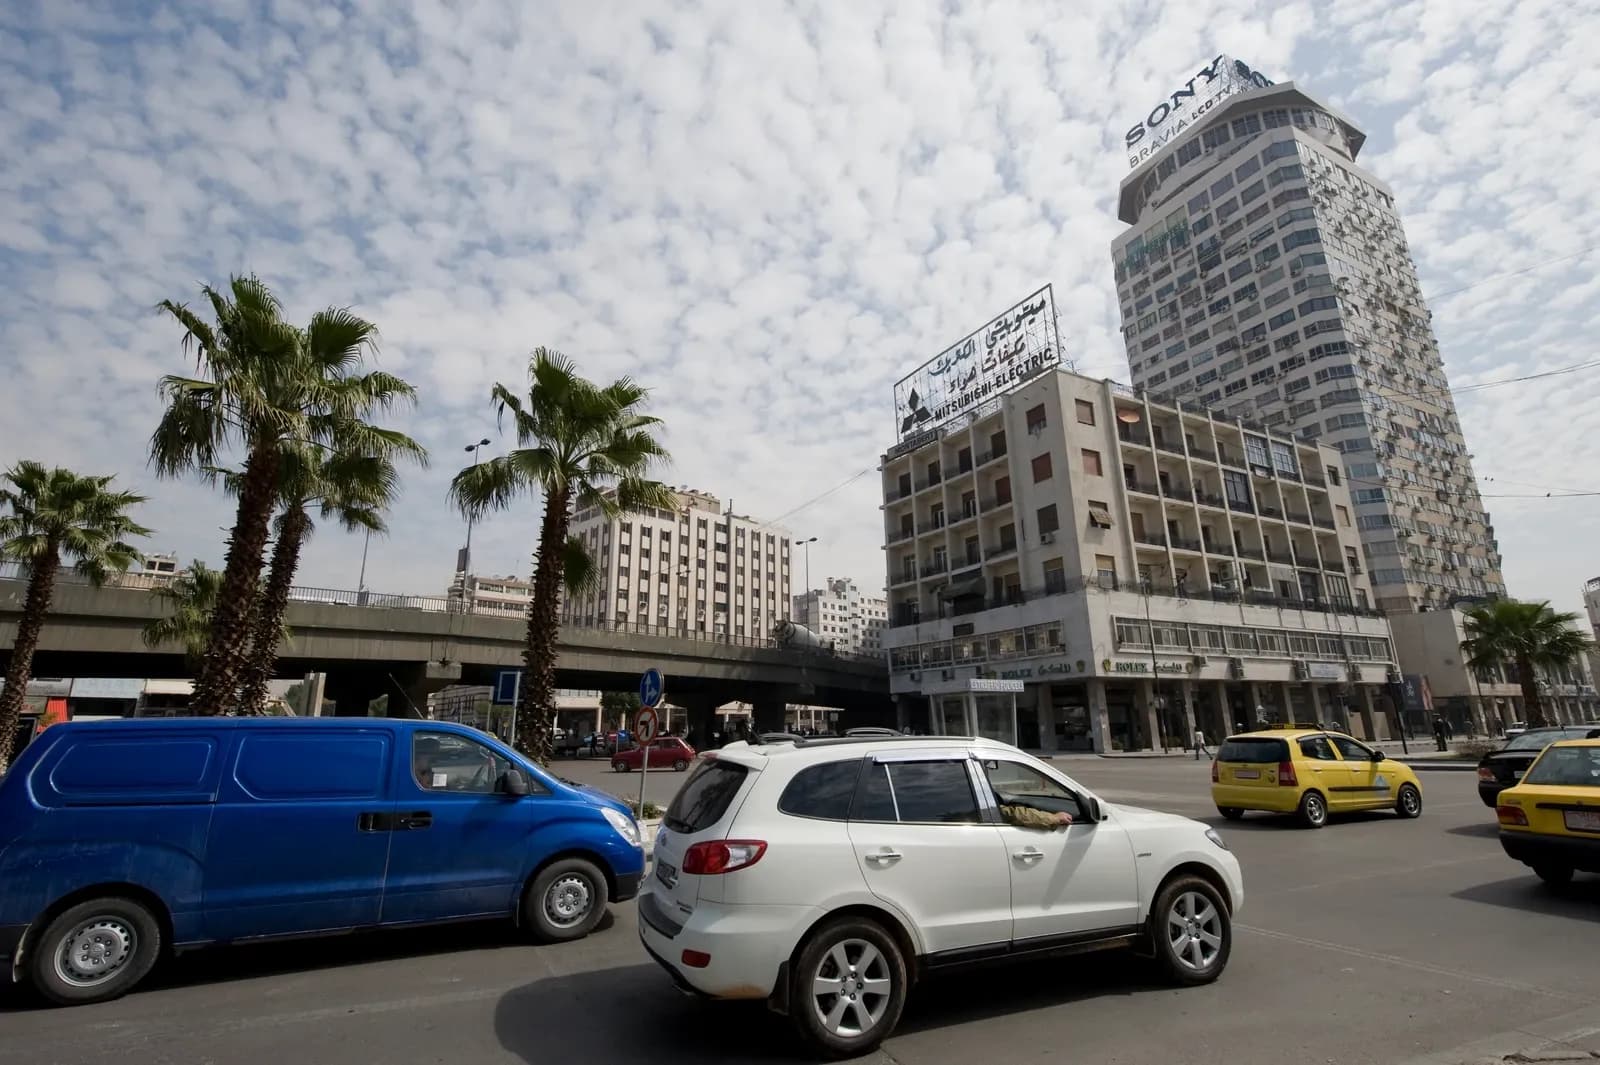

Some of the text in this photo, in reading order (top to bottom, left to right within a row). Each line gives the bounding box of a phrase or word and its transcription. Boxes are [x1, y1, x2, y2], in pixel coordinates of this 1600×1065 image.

[1126, 55, 1223, 149] SONY
[1130, 119, 1188, 168] BRAVIA
[1191, 100, 1213, 120] LCD
[1215, 84, 1231, 103] TV
[1001, 669, 1032, 679] ROLEX
[1116, 662, 1148, 672] ROLEX
